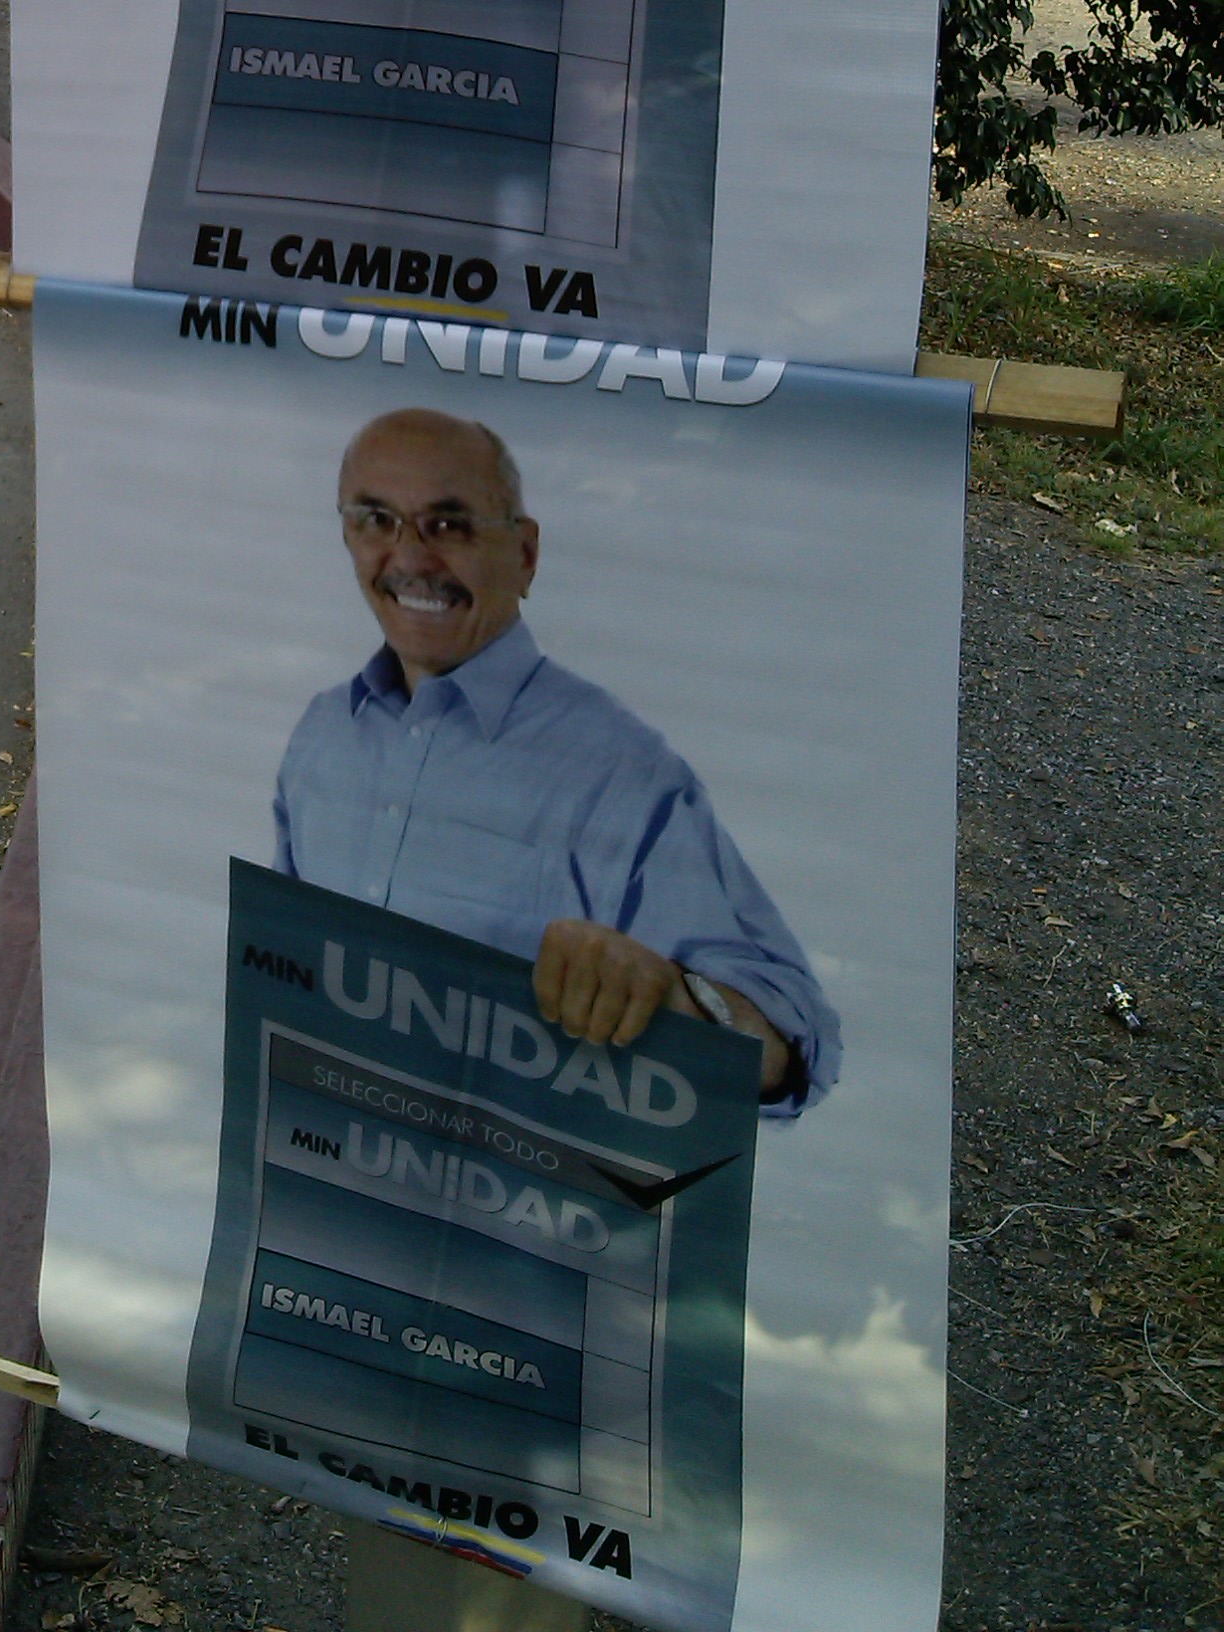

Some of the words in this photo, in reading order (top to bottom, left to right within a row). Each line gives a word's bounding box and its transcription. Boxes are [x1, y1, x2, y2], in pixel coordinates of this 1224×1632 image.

[229, 46, 361, 85] ISMAEL
[372, 60, 521, 106] GARCIA
[179, 296, 279, 349] MIN
[192, 224, 249, 271] EL
[270, 234, 499, 305] CAMBIO
[523, 264, 600, 319] VA
[242, 942, 315, 993] MIN
[322, 939, 698, 1129] UNIDAD
[313, 1064, 474, 1138] SELECCIONAR
[479, 1123, 560, 1171] TODO
[290, 1126, 342, 1161] MIN
[347, 1121, 610, 1254] UNIDAD
[260, 1282, 390, 1344] ISMAEL
[401, 1326, 546, 1391] GARCIA
[244, 1423, 300, 1462] EL
[317, 1450, 539, 1540] CAMBIO
[562, 1514, 634, 1581] VA
